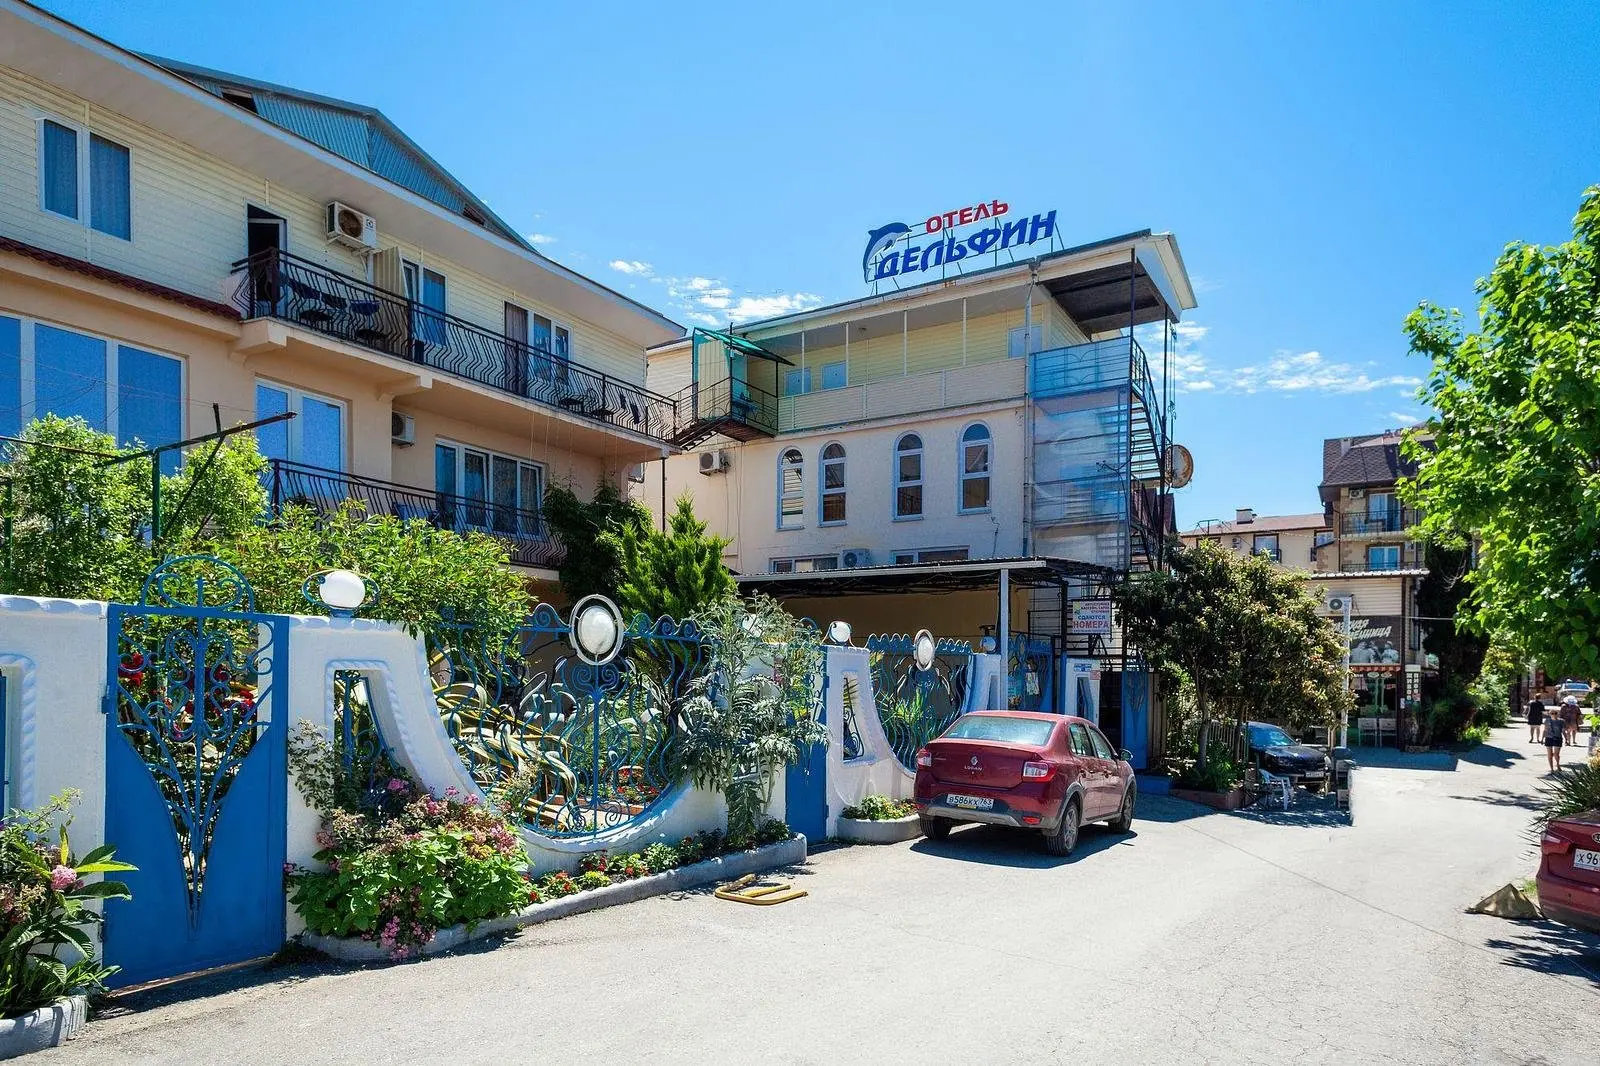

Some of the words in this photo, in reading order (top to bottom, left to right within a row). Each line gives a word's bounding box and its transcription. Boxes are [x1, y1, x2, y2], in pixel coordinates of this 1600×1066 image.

[925, 200, 1009, 234] ОТЕЛЬ
[873, 210, 1057, 281] ДЕЛЬФИН
[1072, 620, 1109, 628] НОМЕРА
